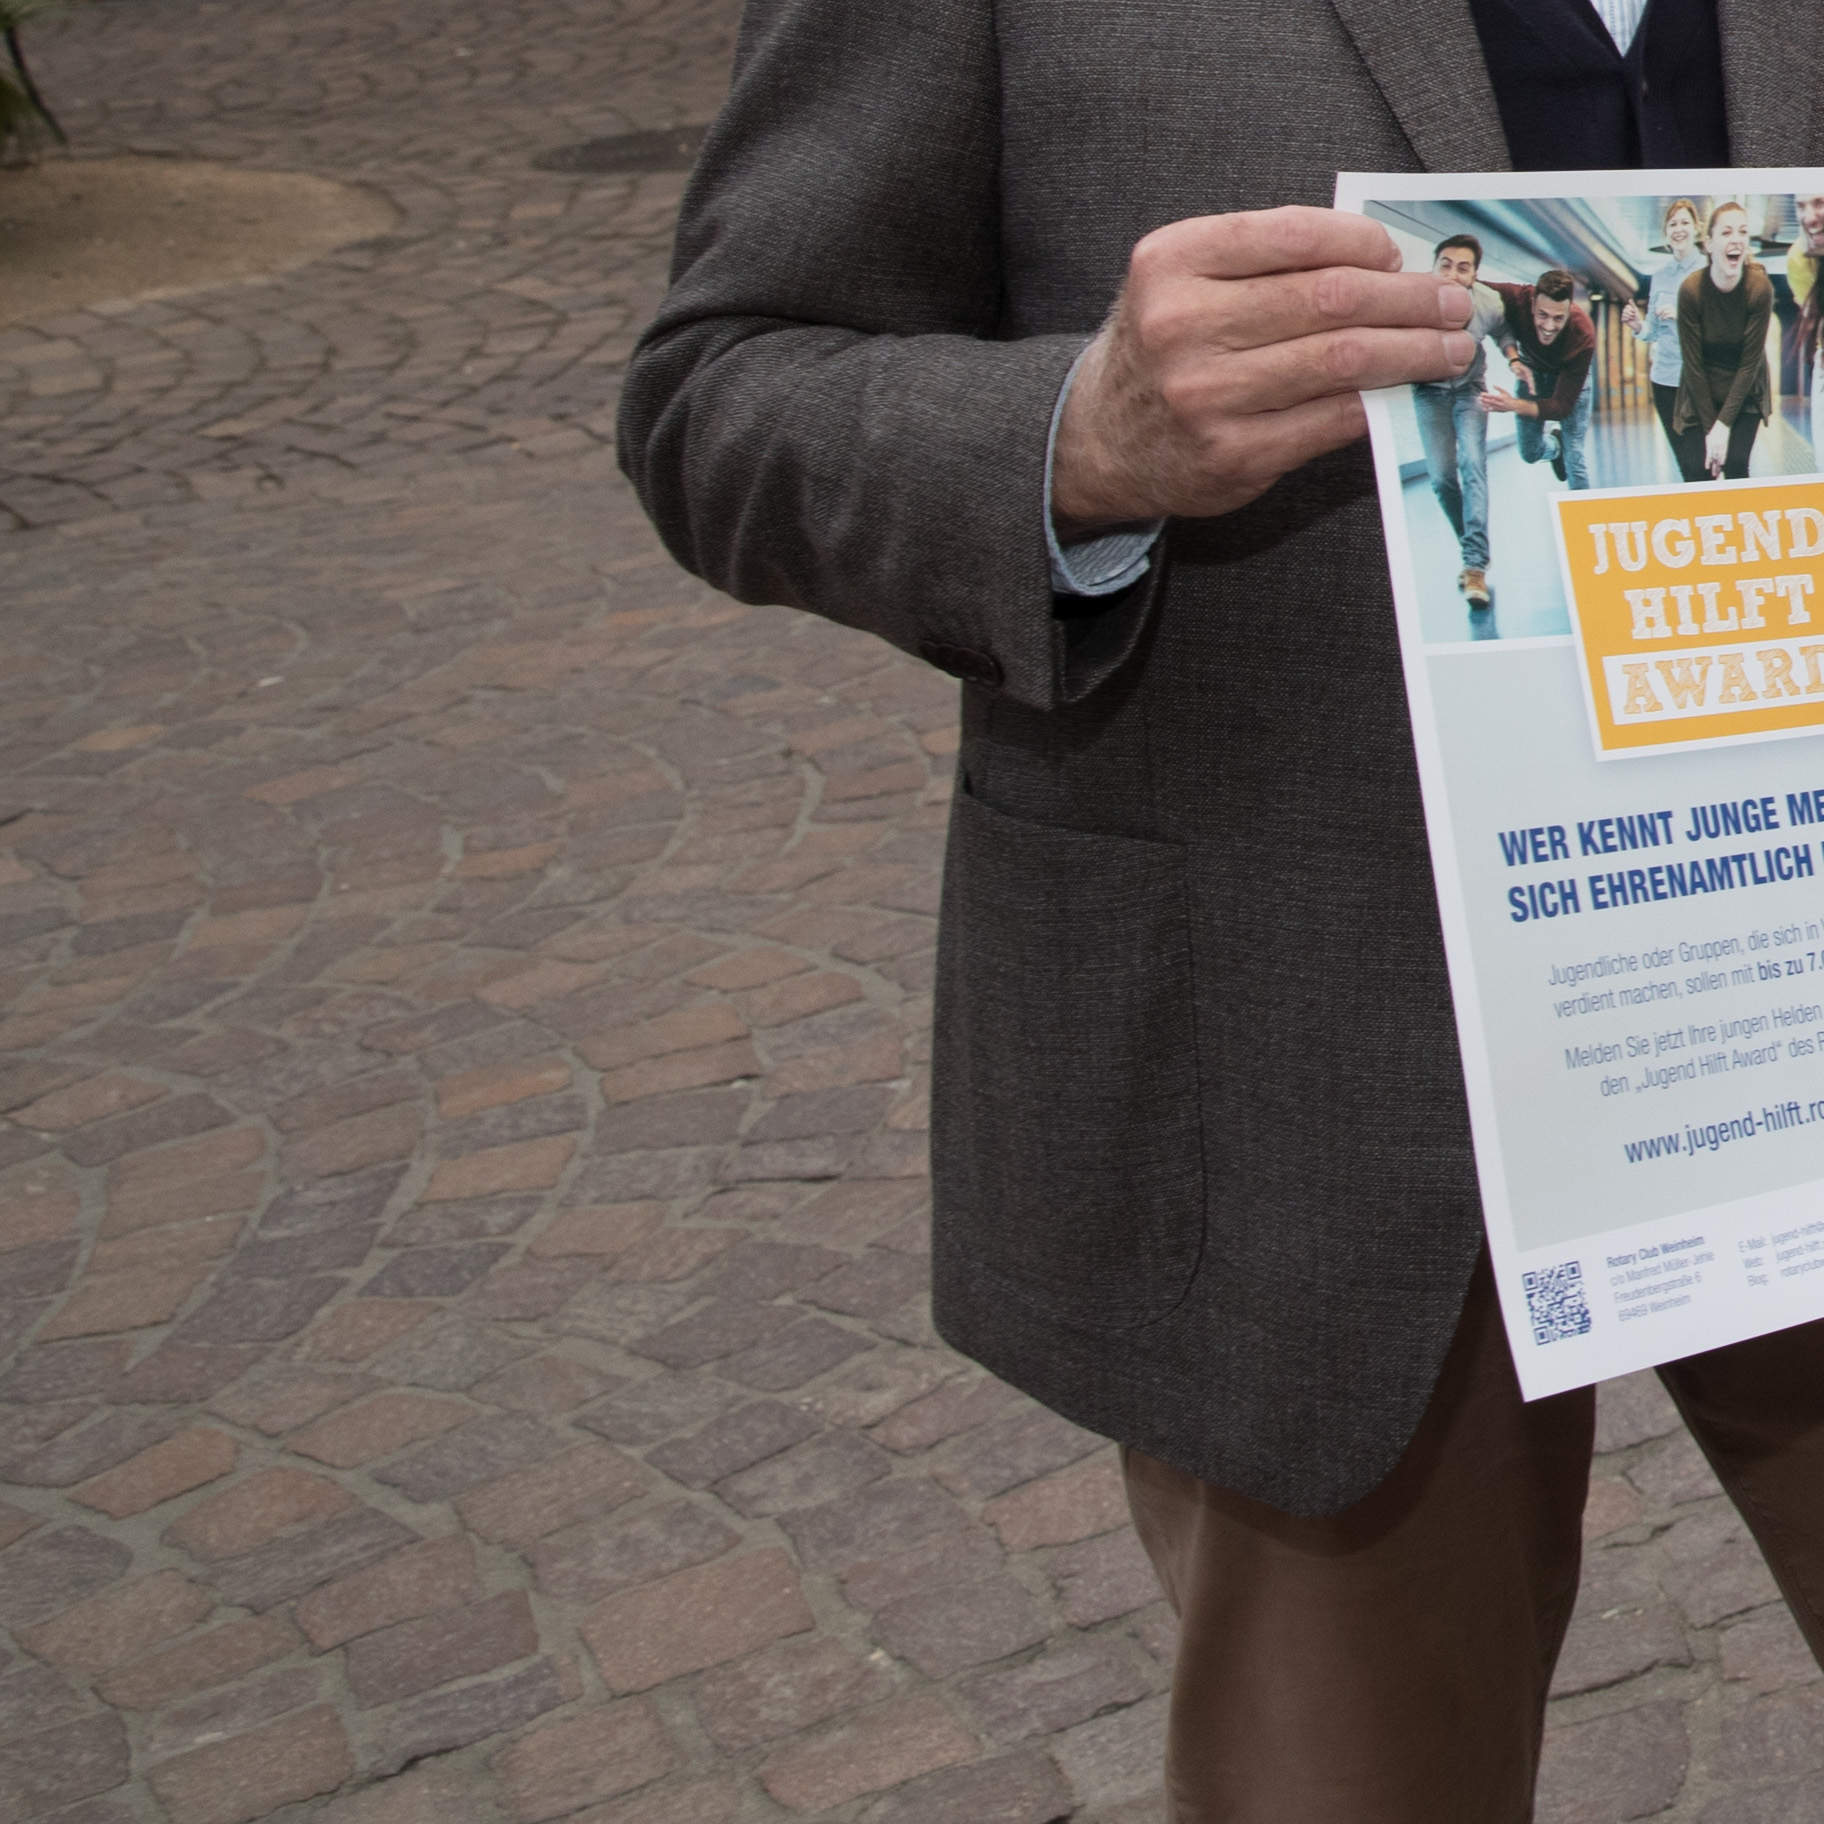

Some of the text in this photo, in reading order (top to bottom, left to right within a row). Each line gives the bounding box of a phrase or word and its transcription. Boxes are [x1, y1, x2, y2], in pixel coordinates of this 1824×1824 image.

[1622, 573, 1815, 640] HILFT
[1497, 824, 1571, 867] WER
[1576, 810, 1673, 857] KENNT
[1685, 796, 1781, 842] JUNGE
[1507, 878, 1581, 923] SICH
[1587, 843, 1815, 911] EHRENAMTLICH
